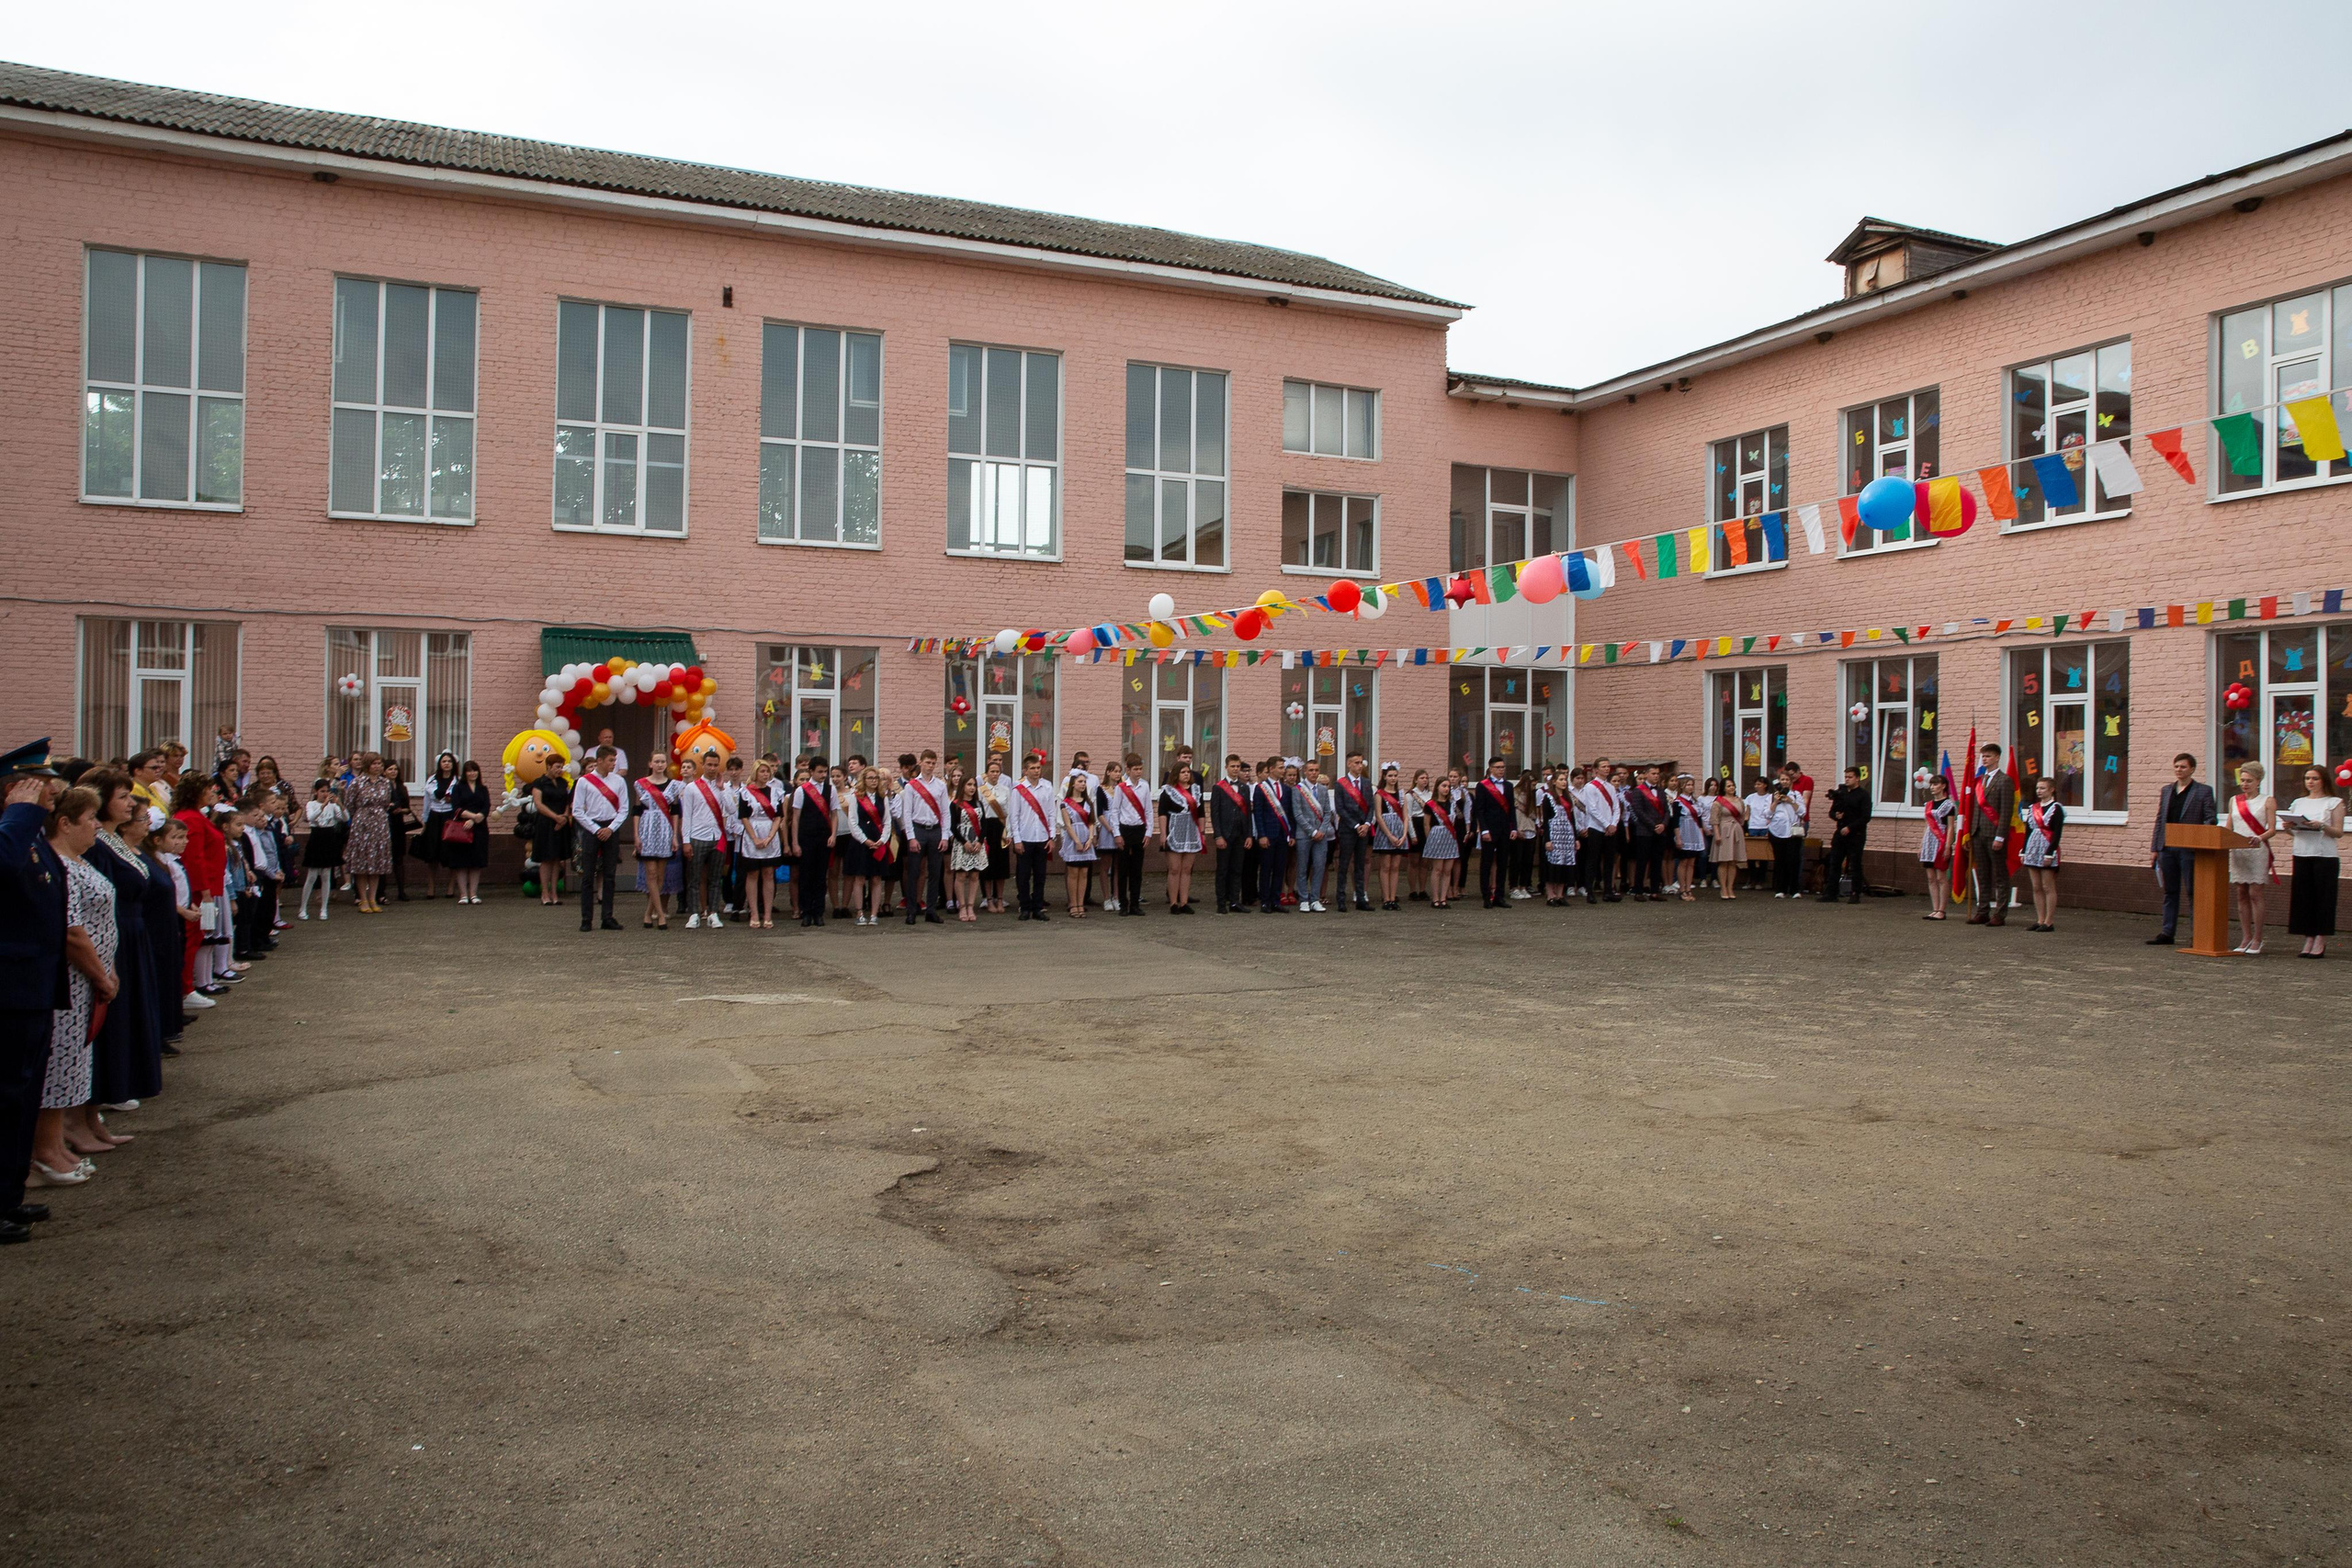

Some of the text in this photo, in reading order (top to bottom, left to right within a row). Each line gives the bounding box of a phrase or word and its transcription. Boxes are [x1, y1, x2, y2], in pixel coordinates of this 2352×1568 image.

[769, 667, 784, 684] 4
[847, 672, 862, 690] 4
[2023, 673, 2039, 694] 5
[2106, 671, 2120, 694] 4
[763, 699, 775, 713] А
[851, 719, 862, 734] А
[2027, 710, 2040, 727] Б
[2025, 758, 2038, 775] Е
[2104, 755, 2119, 773] Д
